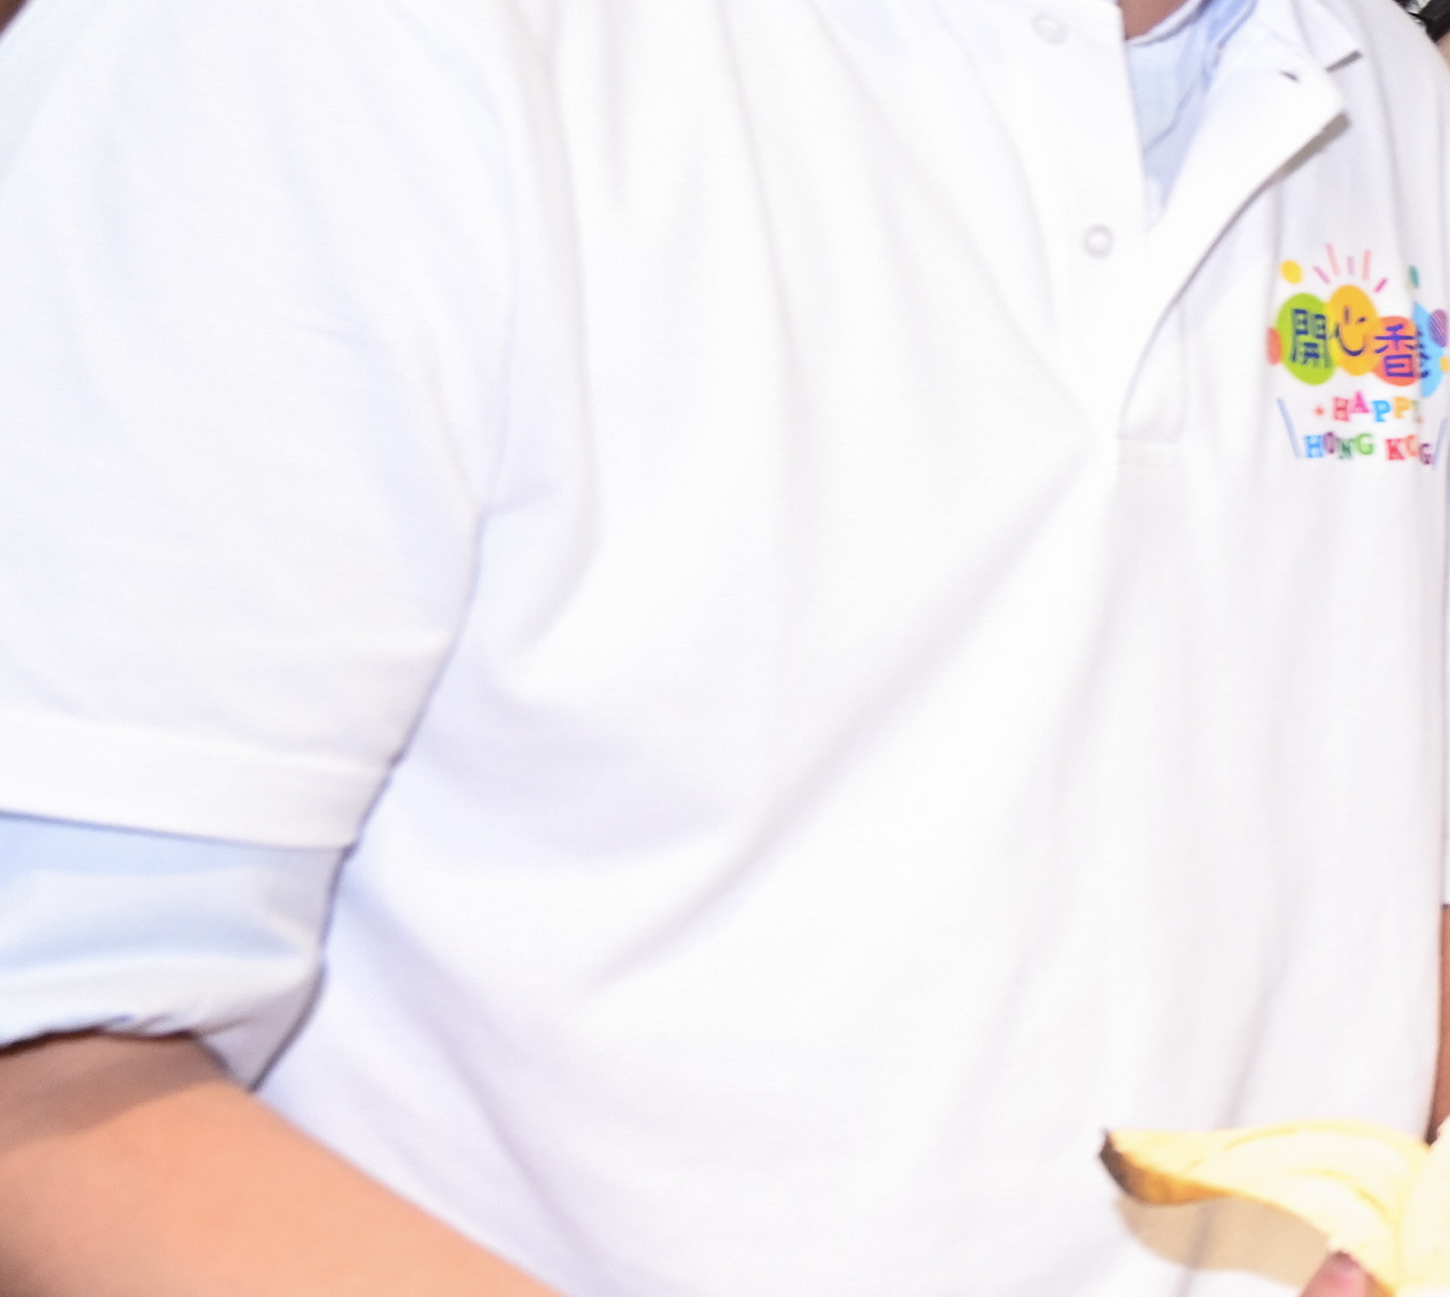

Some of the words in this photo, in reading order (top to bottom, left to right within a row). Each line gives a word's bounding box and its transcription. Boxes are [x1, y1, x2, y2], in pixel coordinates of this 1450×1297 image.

[1290, 305, 1431, 379] 開心香
[1304, 431, 1375, 459] HONG
